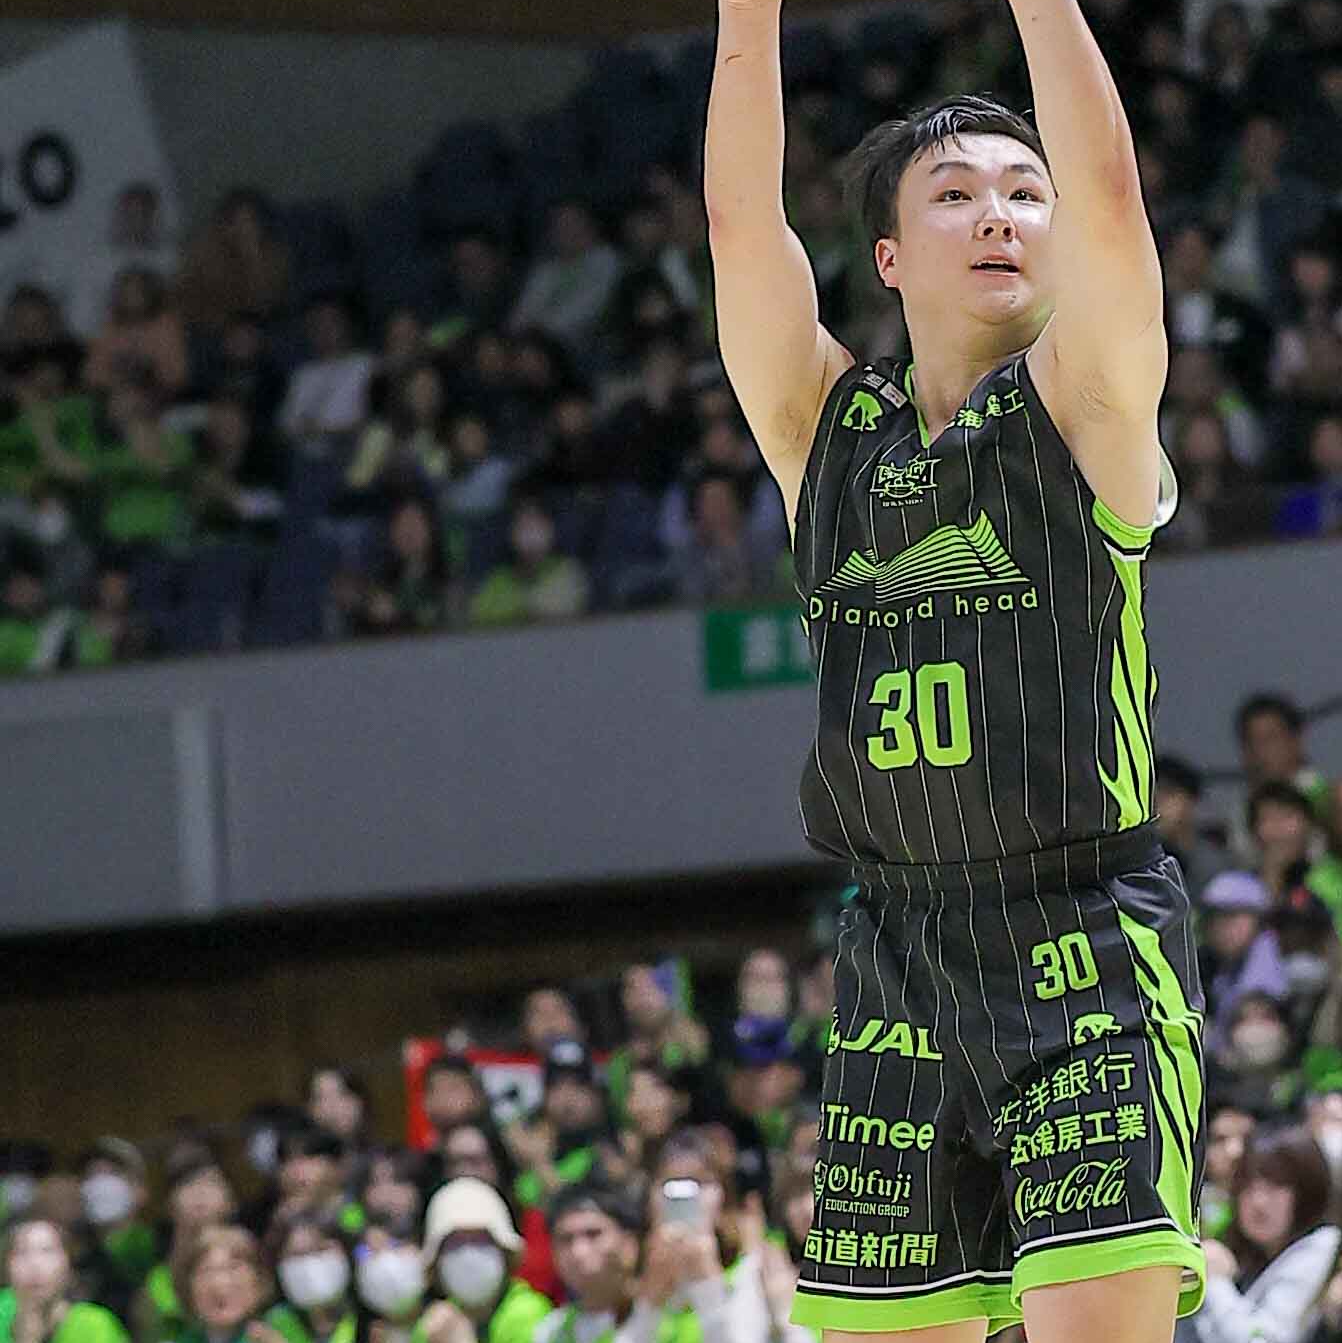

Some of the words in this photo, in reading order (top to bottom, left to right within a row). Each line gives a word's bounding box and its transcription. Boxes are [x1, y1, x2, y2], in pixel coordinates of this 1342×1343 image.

[955, 587, 1038, 616] head
[867, 661, 972, 770] 30
[1032, 930, 1098, 1001] 30
[841, 1019, 943, 1060] JAL
[993, 1053, 1136, 1137] 北洋銀行
[826, 1104, 935, 1151] Timee
[828, 1165, 911, 1202] Ohfuji
[1014, 1155, 1131, 1225] Coca-Cola
[825, 1199, 877, 1215] EDUCATION
[877, 1204, 910, 1218] GROUP
